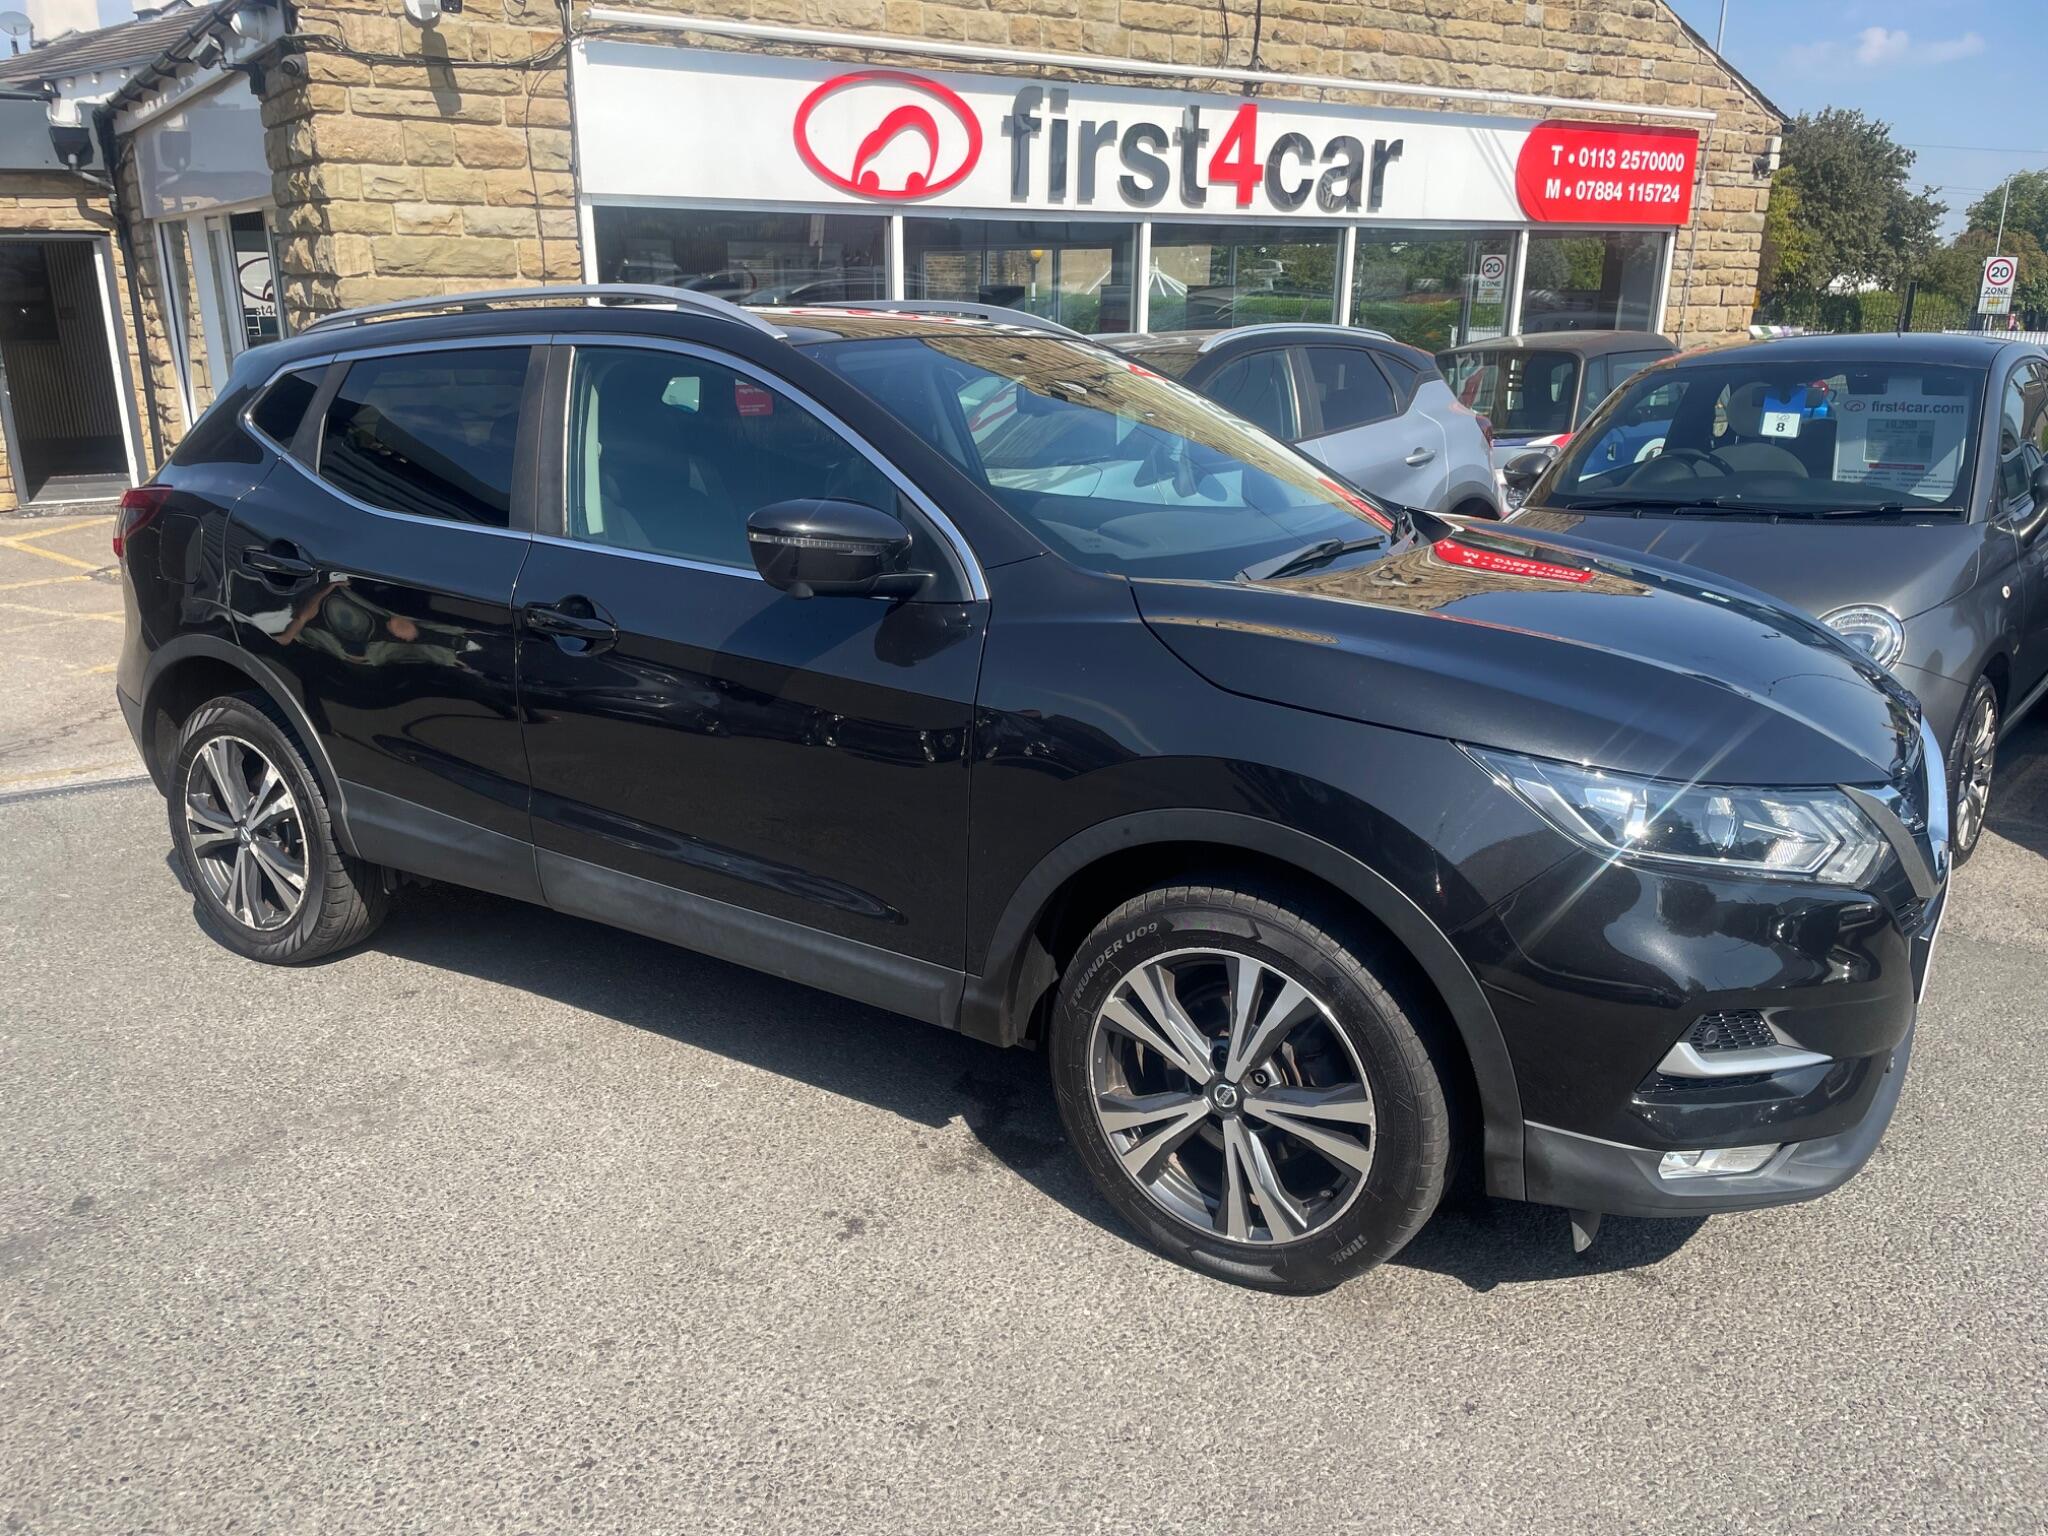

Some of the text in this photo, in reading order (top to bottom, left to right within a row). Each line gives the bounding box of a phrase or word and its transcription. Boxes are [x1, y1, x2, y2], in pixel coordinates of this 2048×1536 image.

[1001, 85, 1404, 213] first4car
[1551, 145, 1685, 172] T 0113 2570000
[1545, 178, 1681, 203] M 07884 115724
[1485, 263, 1500, 273] 20
[1991, 266, 2009, 278] 20
[1481, 280, 1501, 288] ZONE
[1984, 287, 2009, 295] ZONE
[1871, 400, 1965, 414] first4car.com
[1775, 422, 1785, 432] 8
[1071, 939, 1124, 1007] THUNDER
